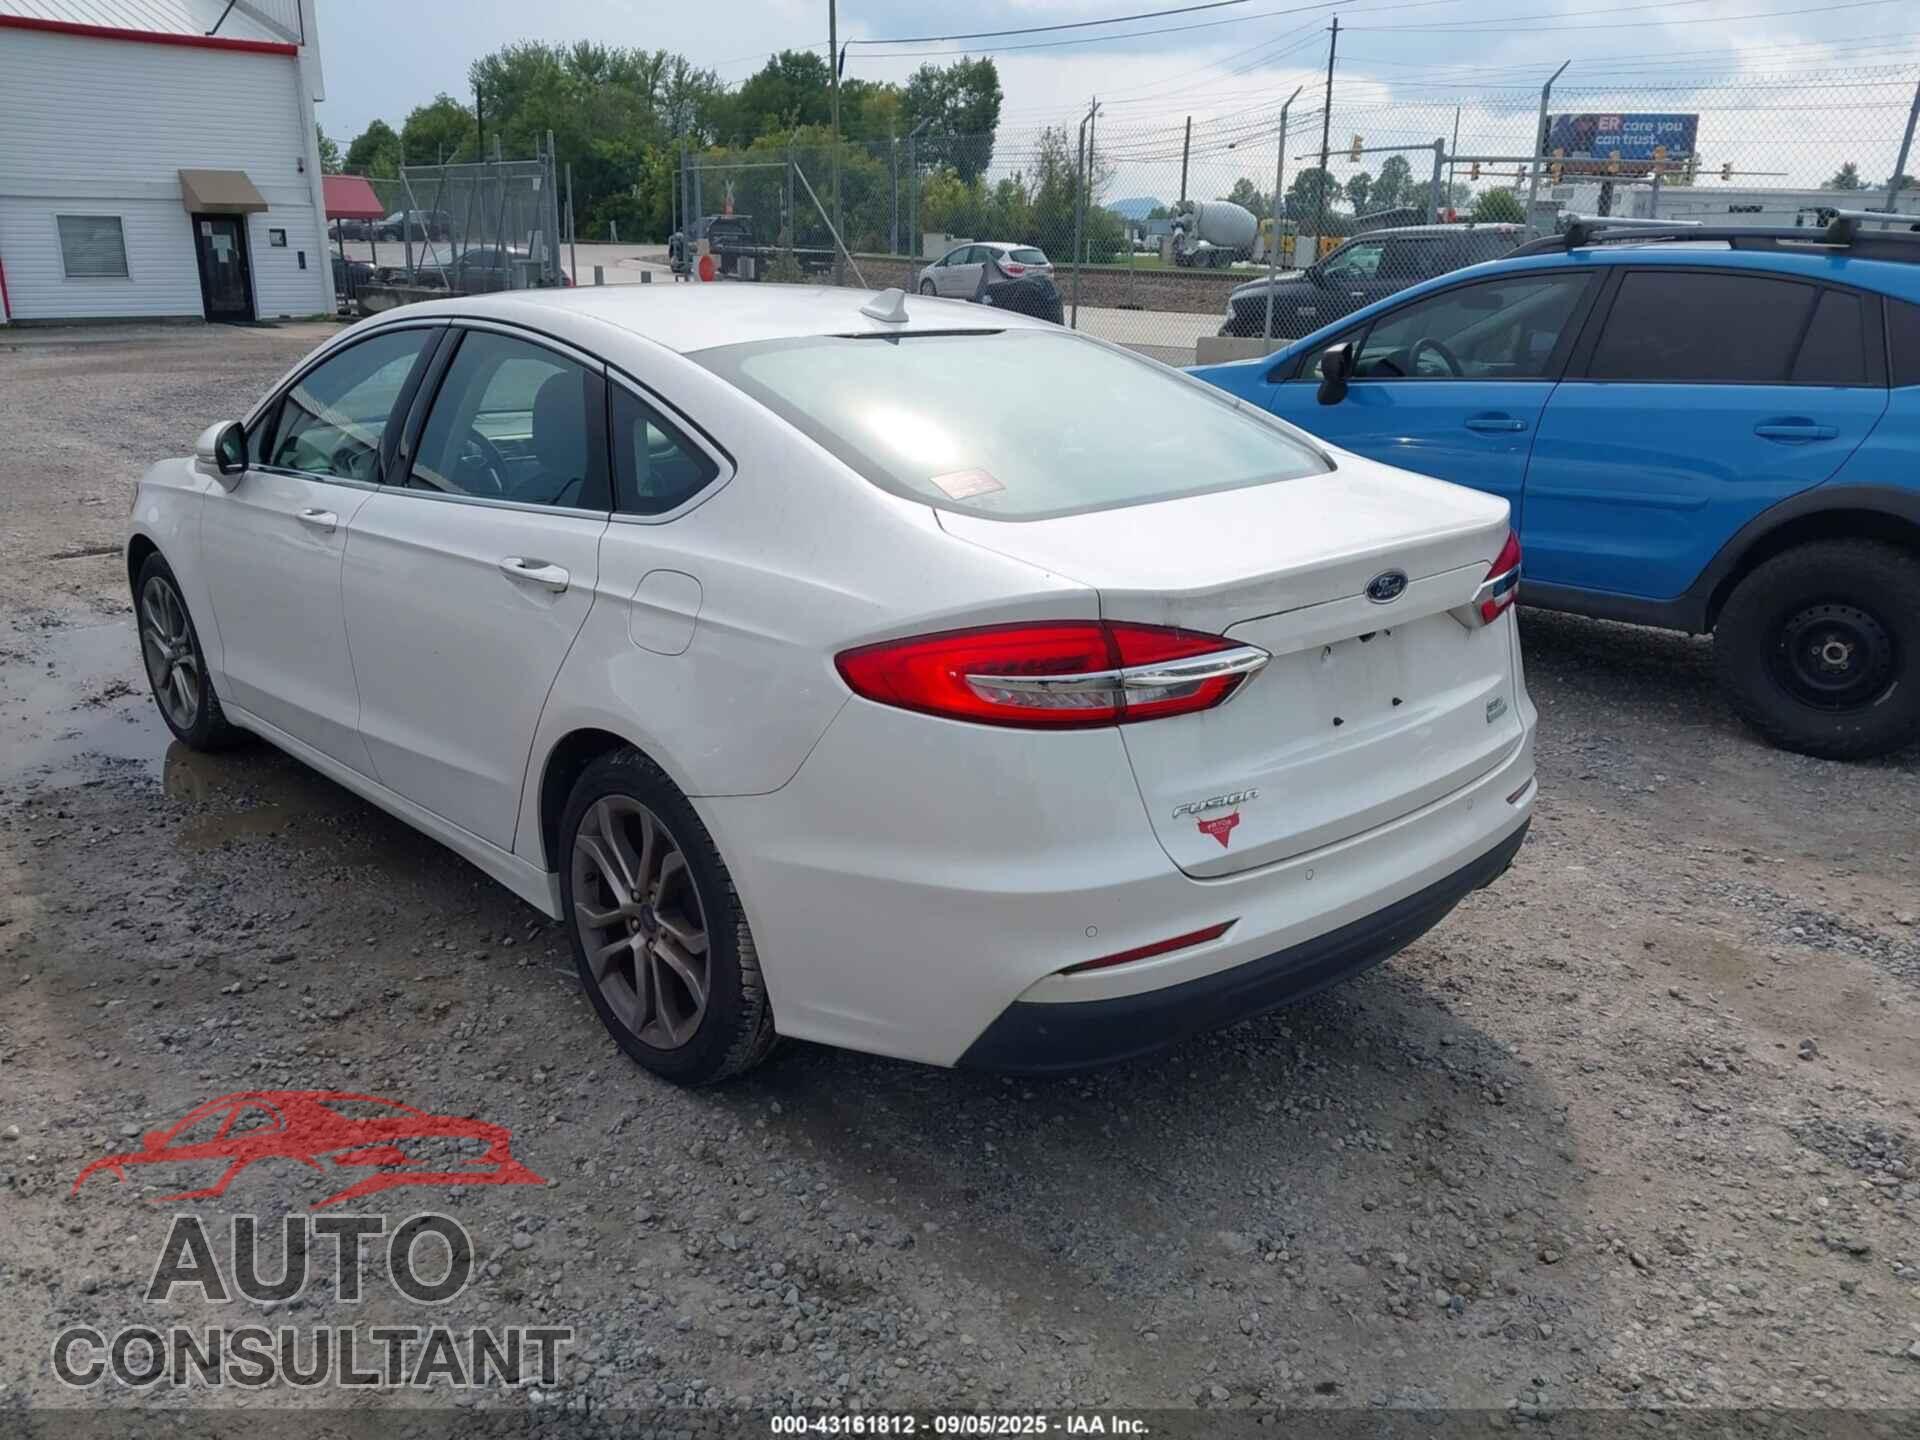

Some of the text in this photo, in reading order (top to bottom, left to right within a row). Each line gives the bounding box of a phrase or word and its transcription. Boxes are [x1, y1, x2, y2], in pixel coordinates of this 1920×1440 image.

[1598, 117, 1683, 134] ER care you
[1595, 134, 1659, 145] can trust.
